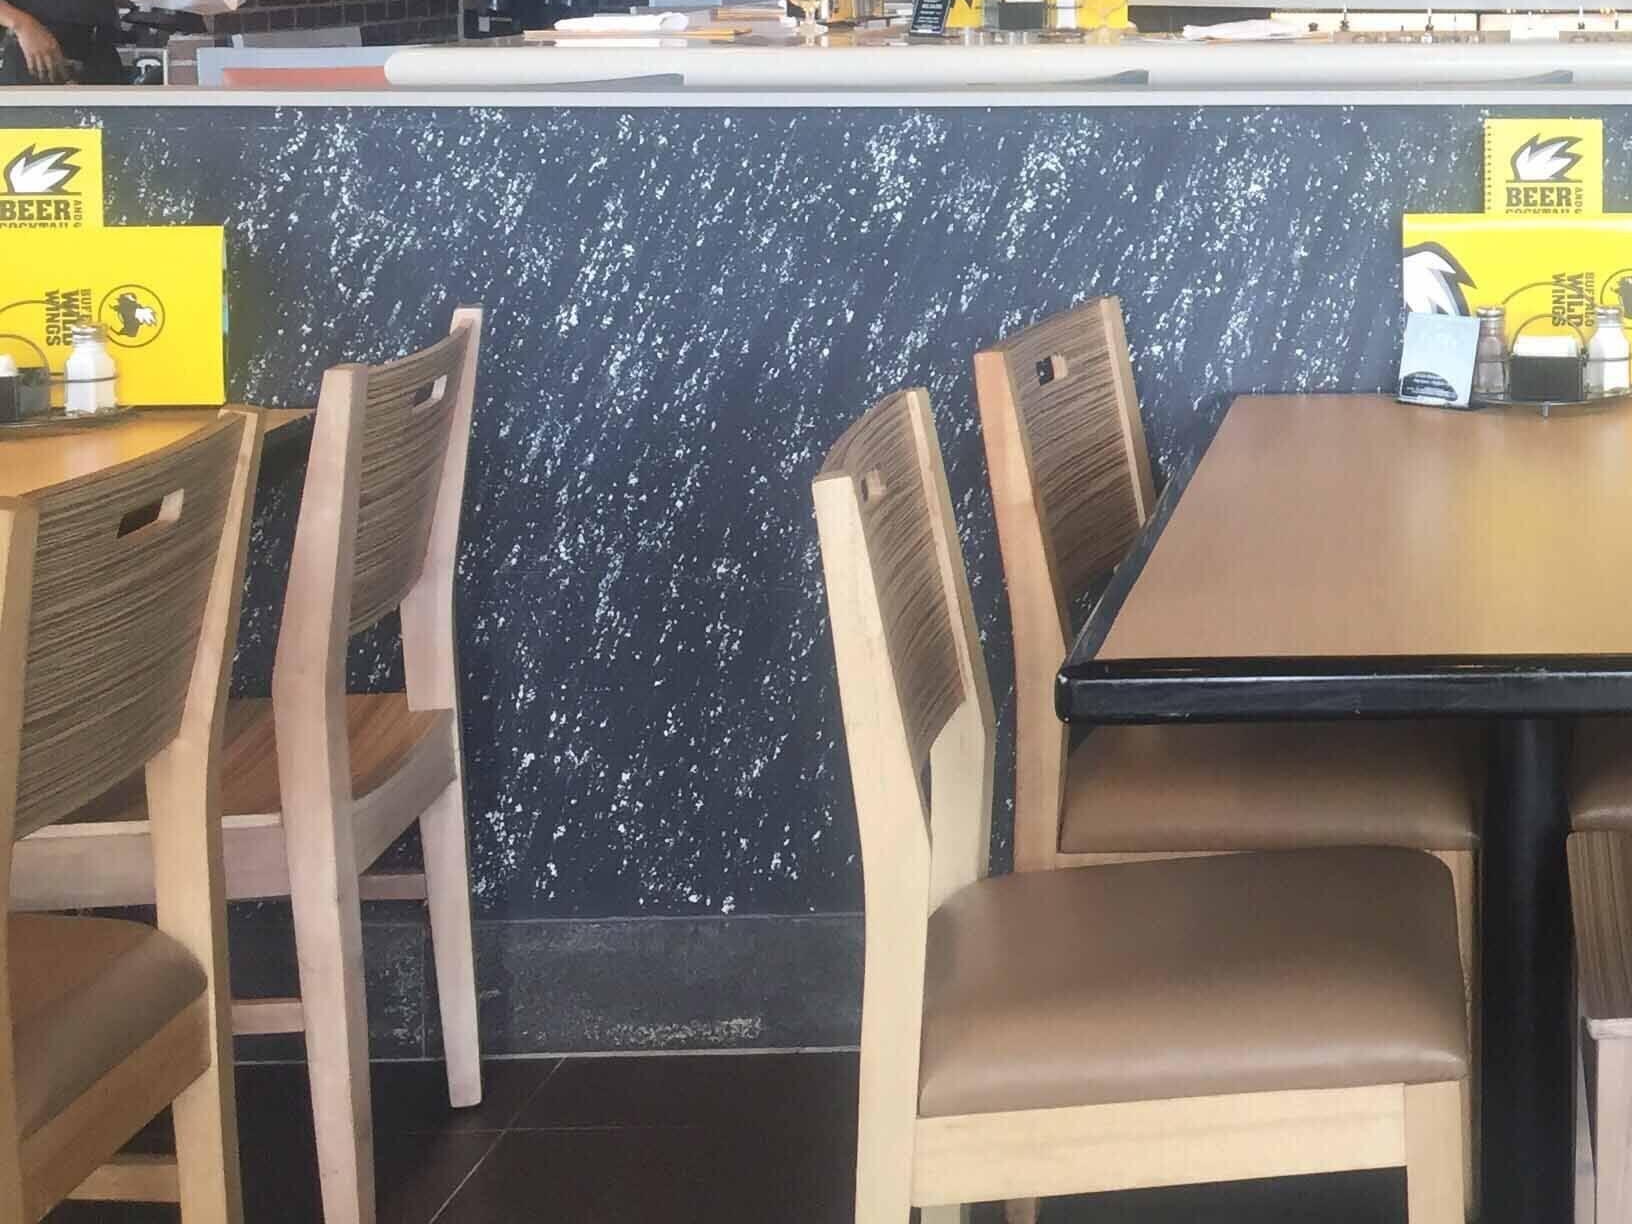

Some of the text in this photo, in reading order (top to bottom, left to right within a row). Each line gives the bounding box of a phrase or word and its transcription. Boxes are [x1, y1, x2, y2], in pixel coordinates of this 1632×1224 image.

[0, 199, 72, 221] BEER
[1505, 186, 1573, 208] BEER
[44, 288, 61, 346] WINGS
[1551, 271, 1567, 327] WINGS
[1566, 271, 1584, 327] WILD
